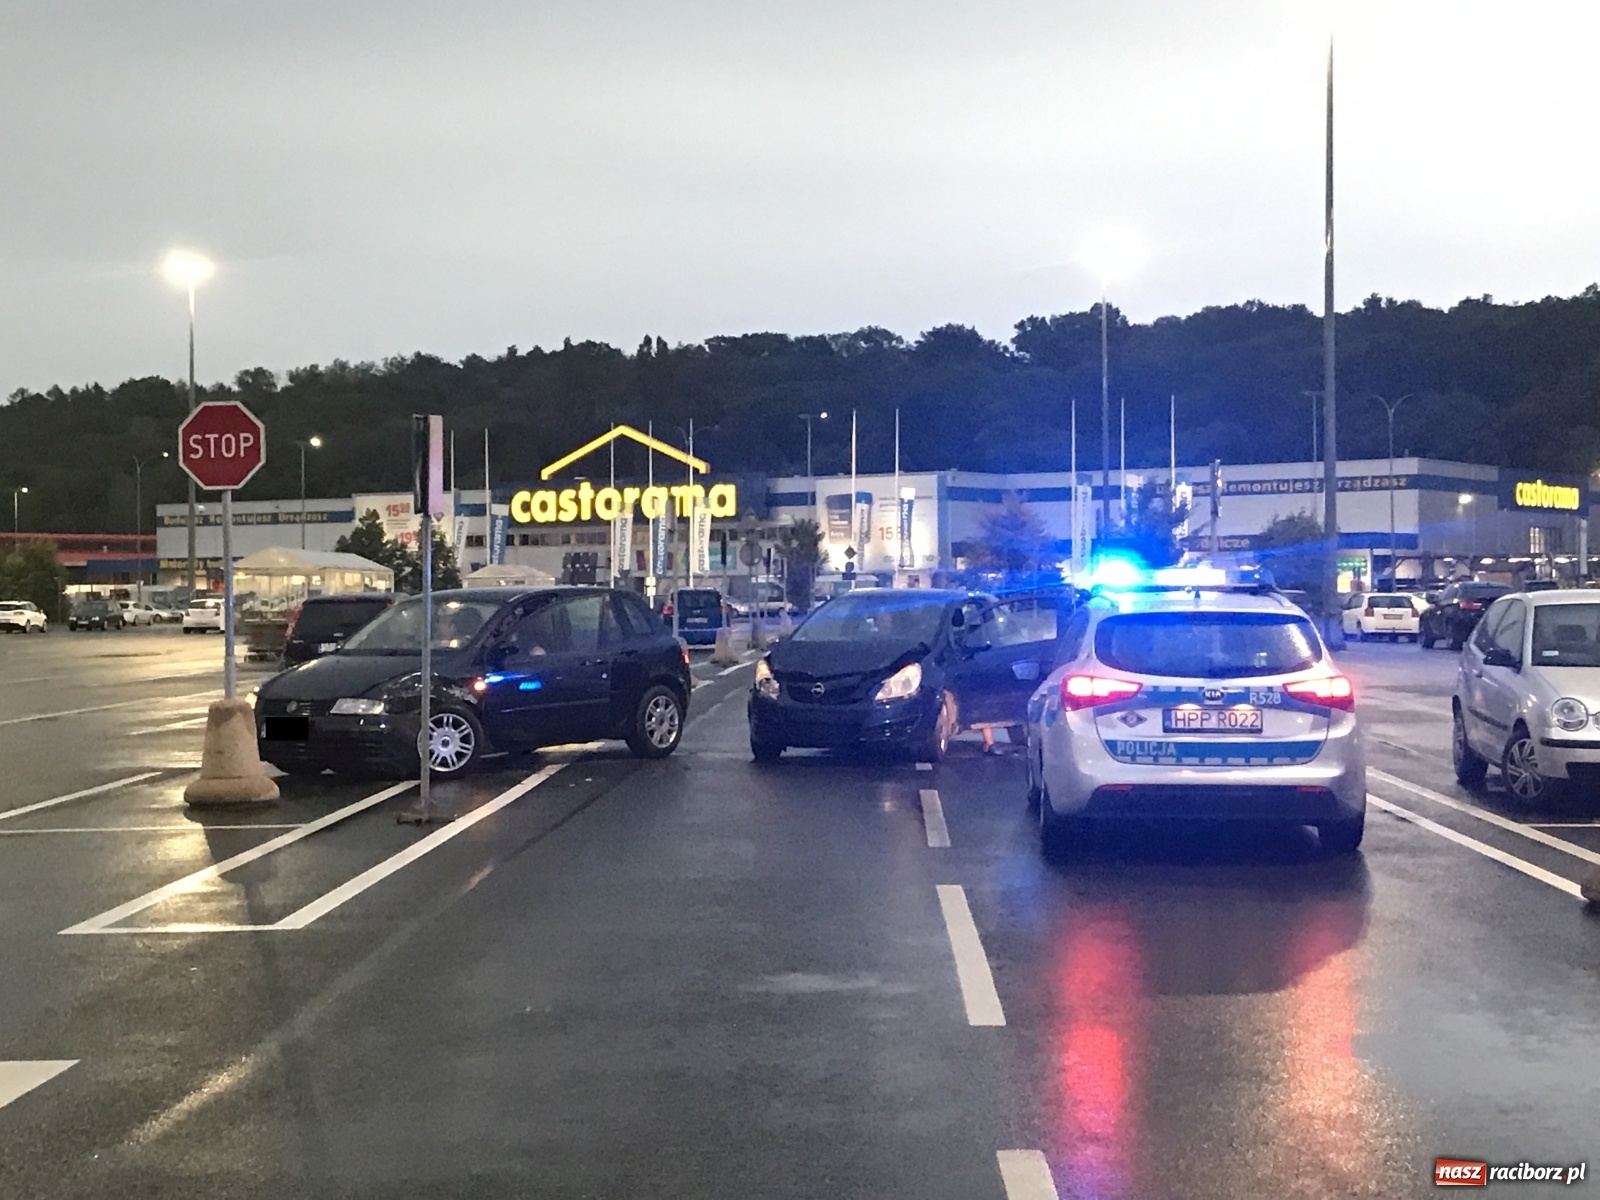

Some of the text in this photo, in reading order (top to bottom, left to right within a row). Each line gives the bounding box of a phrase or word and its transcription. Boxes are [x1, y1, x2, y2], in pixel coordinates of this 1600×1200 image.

[189, 433, 254, 459] STOP
[1337, 475, 1407, 490] rządzasz
[511, 482, 736, 523] castorama
[1516, 479, 1579, 510] castorama
[209, 513, 272, 525] Reontujesz
[493, 519, 503, 564] storama
[618, 517, 628, 568] astorama
[1249, 692, 1282, 705] R528
[1174, 711, 1212, 728] HPP
[1217, 712, 1260, 728] R022
[1116, 740, 1177, 756] POLICJA
